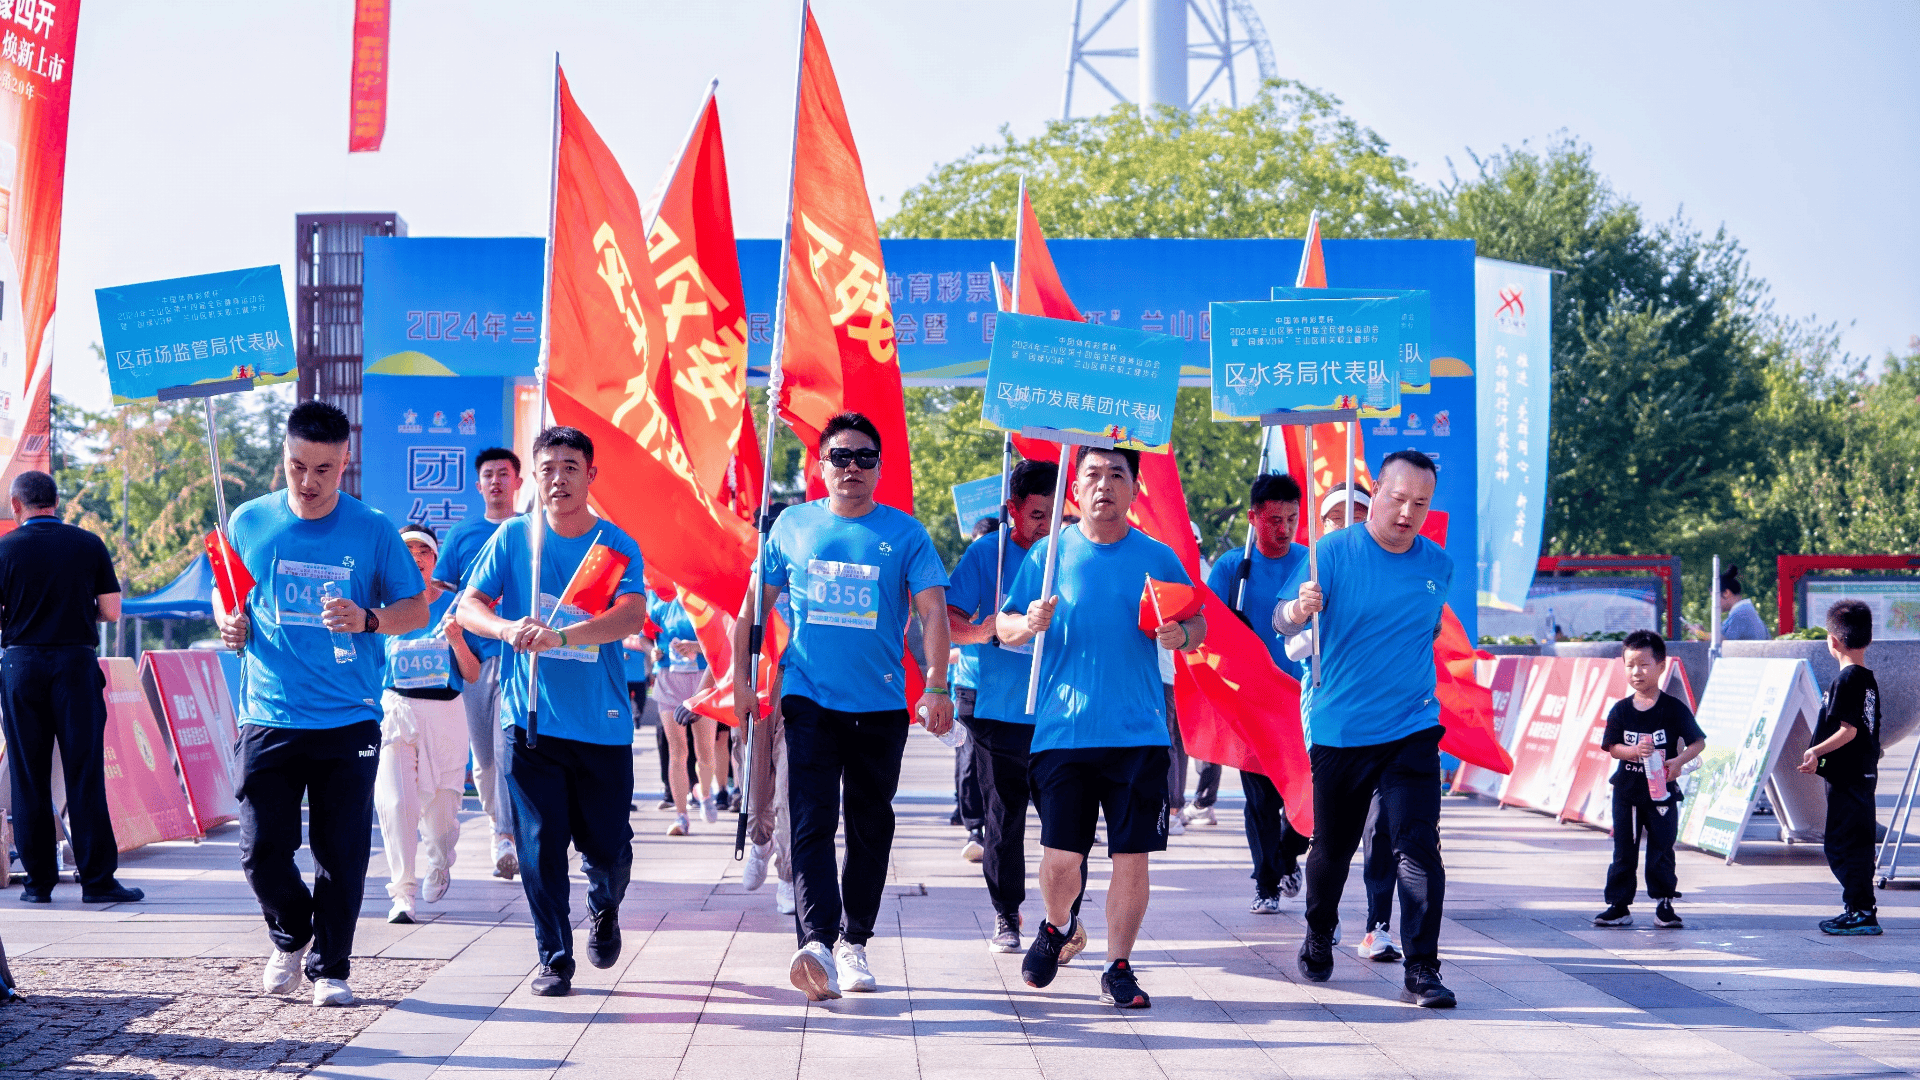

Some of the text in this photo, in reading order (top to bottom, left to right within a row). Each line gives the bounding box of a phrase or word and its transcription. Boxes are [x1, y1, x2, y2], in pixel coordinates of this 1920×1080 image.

[2, 29, 66, 83] 焕新上市
[407, 311, 536, 343] 2024年兰
[750, 313, 771, 344] 民
[116, 330, 284, 370] 区市场监管局代表队
[1225, 360, 1390, 387] 区水务局代表队
[997, 382, 1163, 422] 区城市发展集团代表队
[814, 582, 871, 608] 0356
[398, 655, 444, 672] 0462
